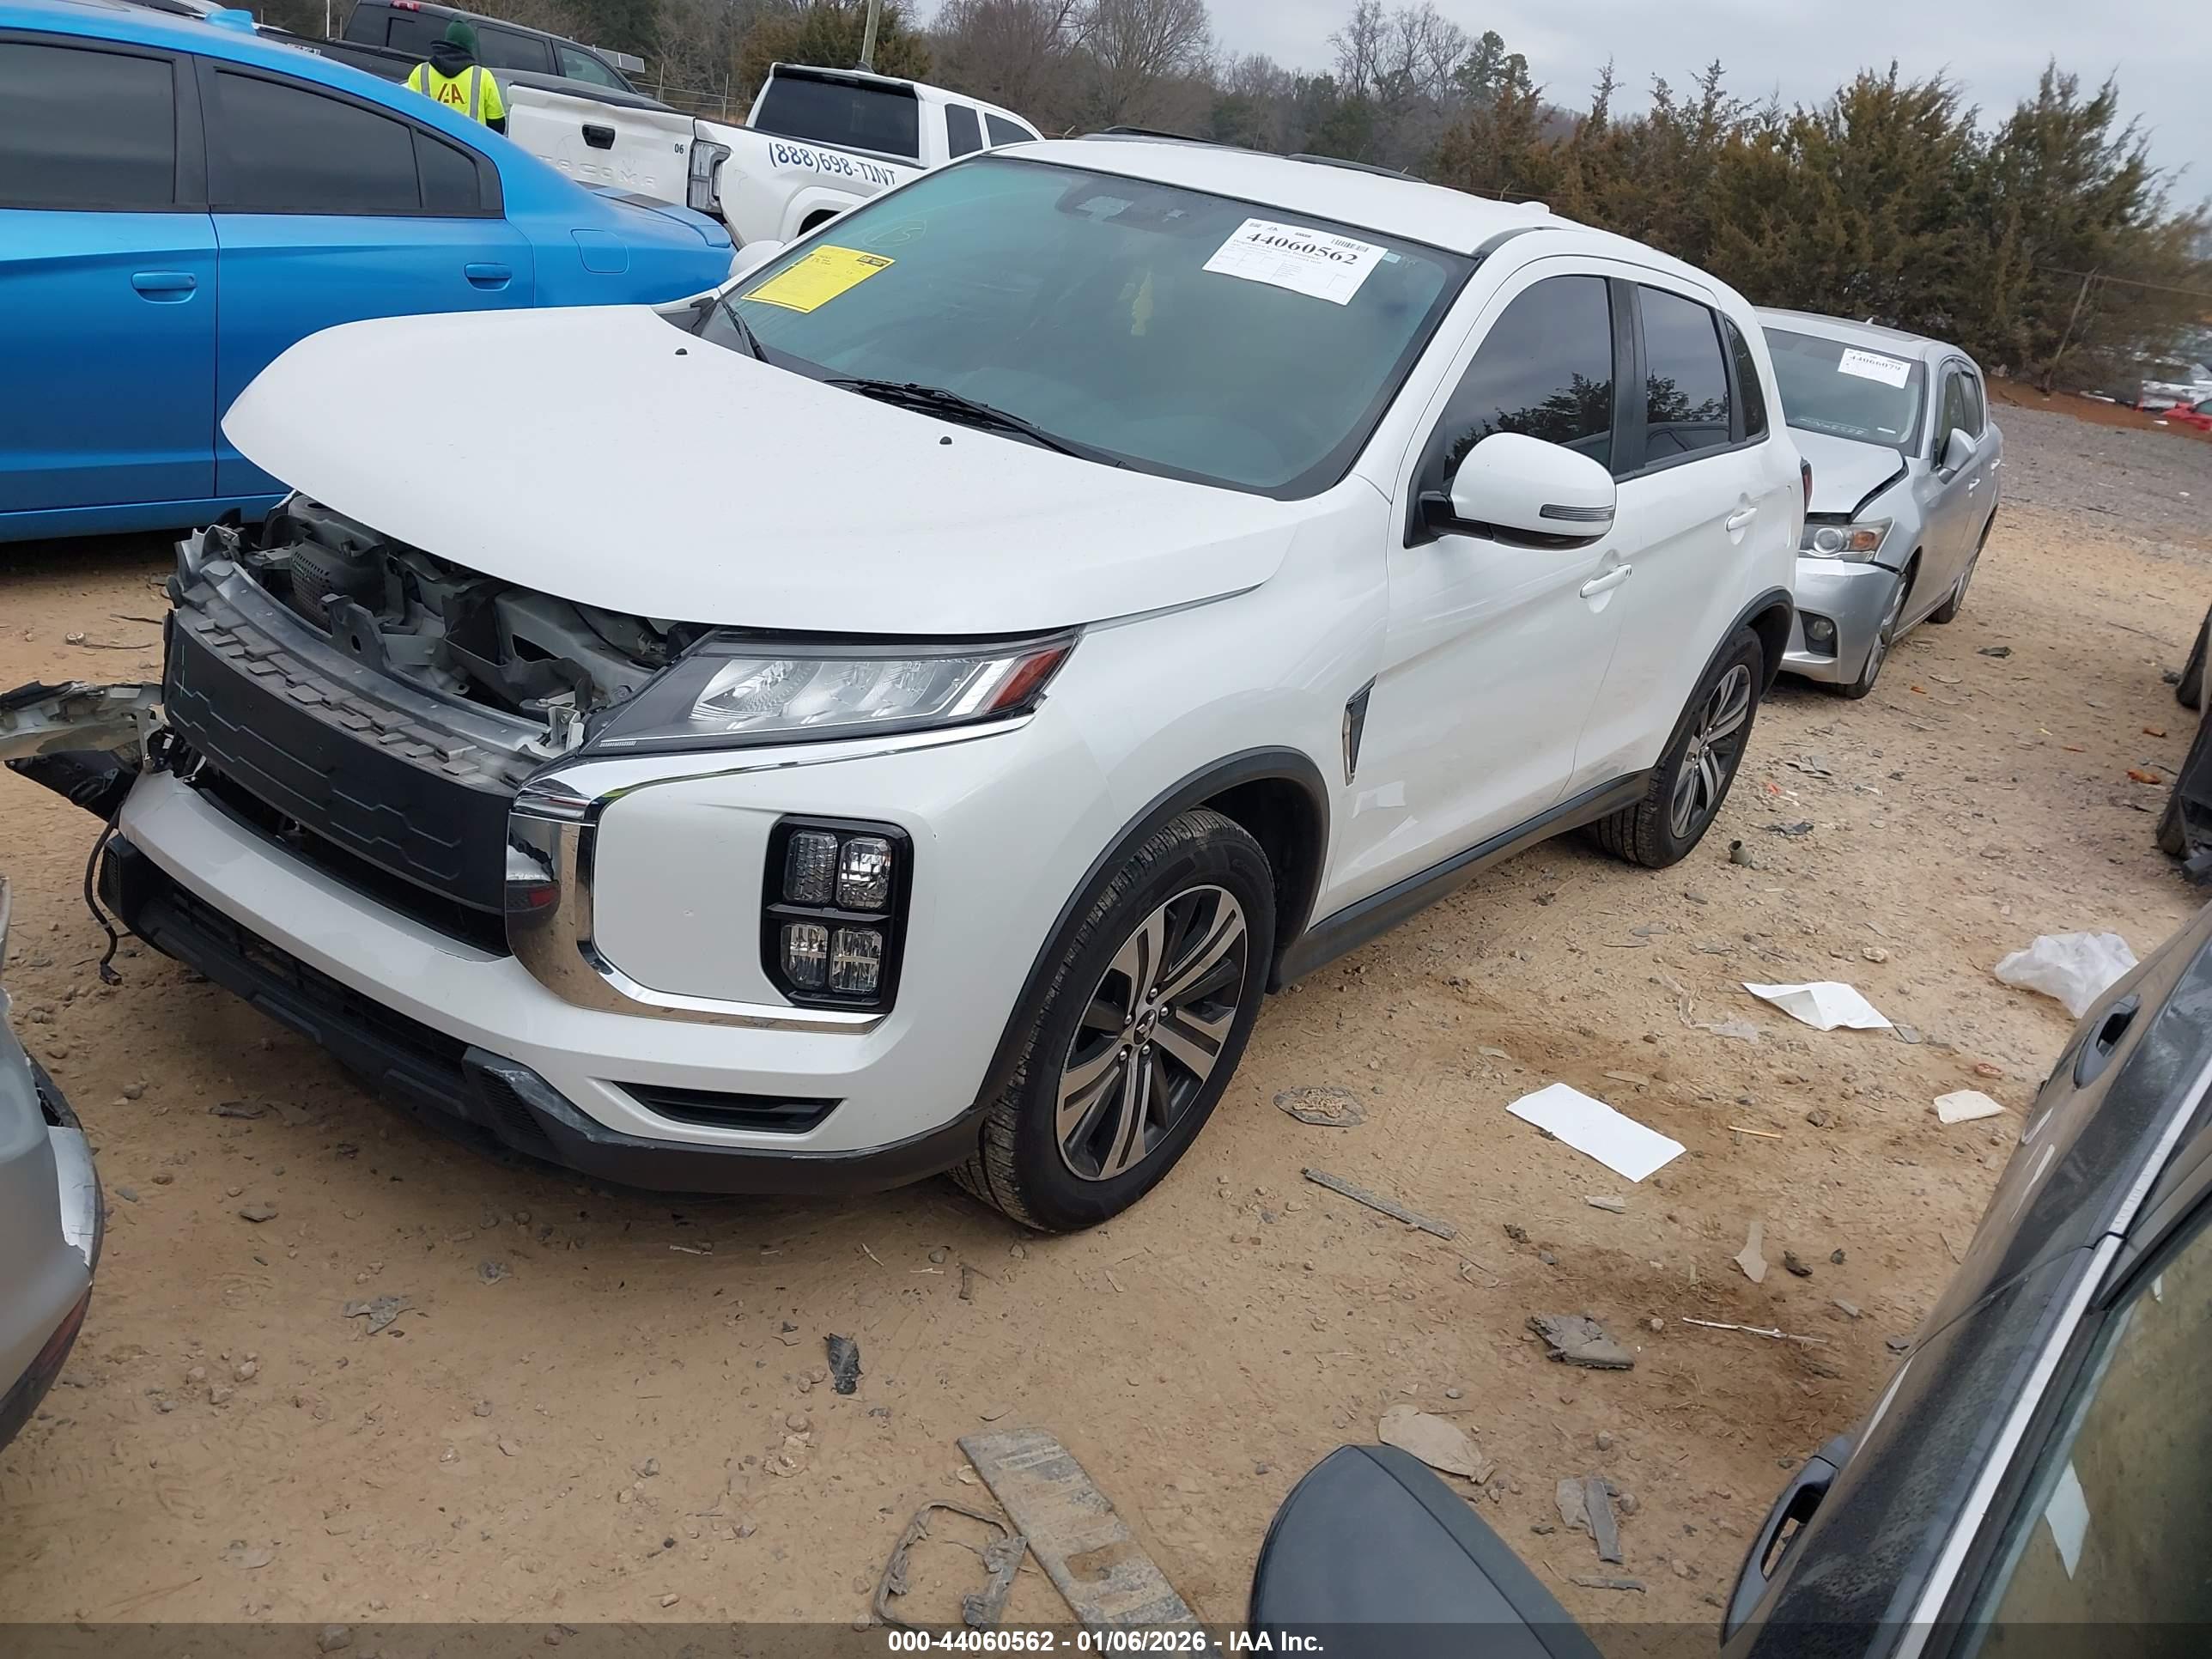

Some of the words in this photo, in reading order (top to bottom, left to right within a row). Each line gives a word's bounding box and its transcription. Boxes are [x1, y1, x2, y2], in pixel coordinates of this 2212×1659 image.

[674, 143, 684, 155] 06
[769, 142, 896, 185] (888)698-TINT
[1247, 233, 1358, 264] 44060562
